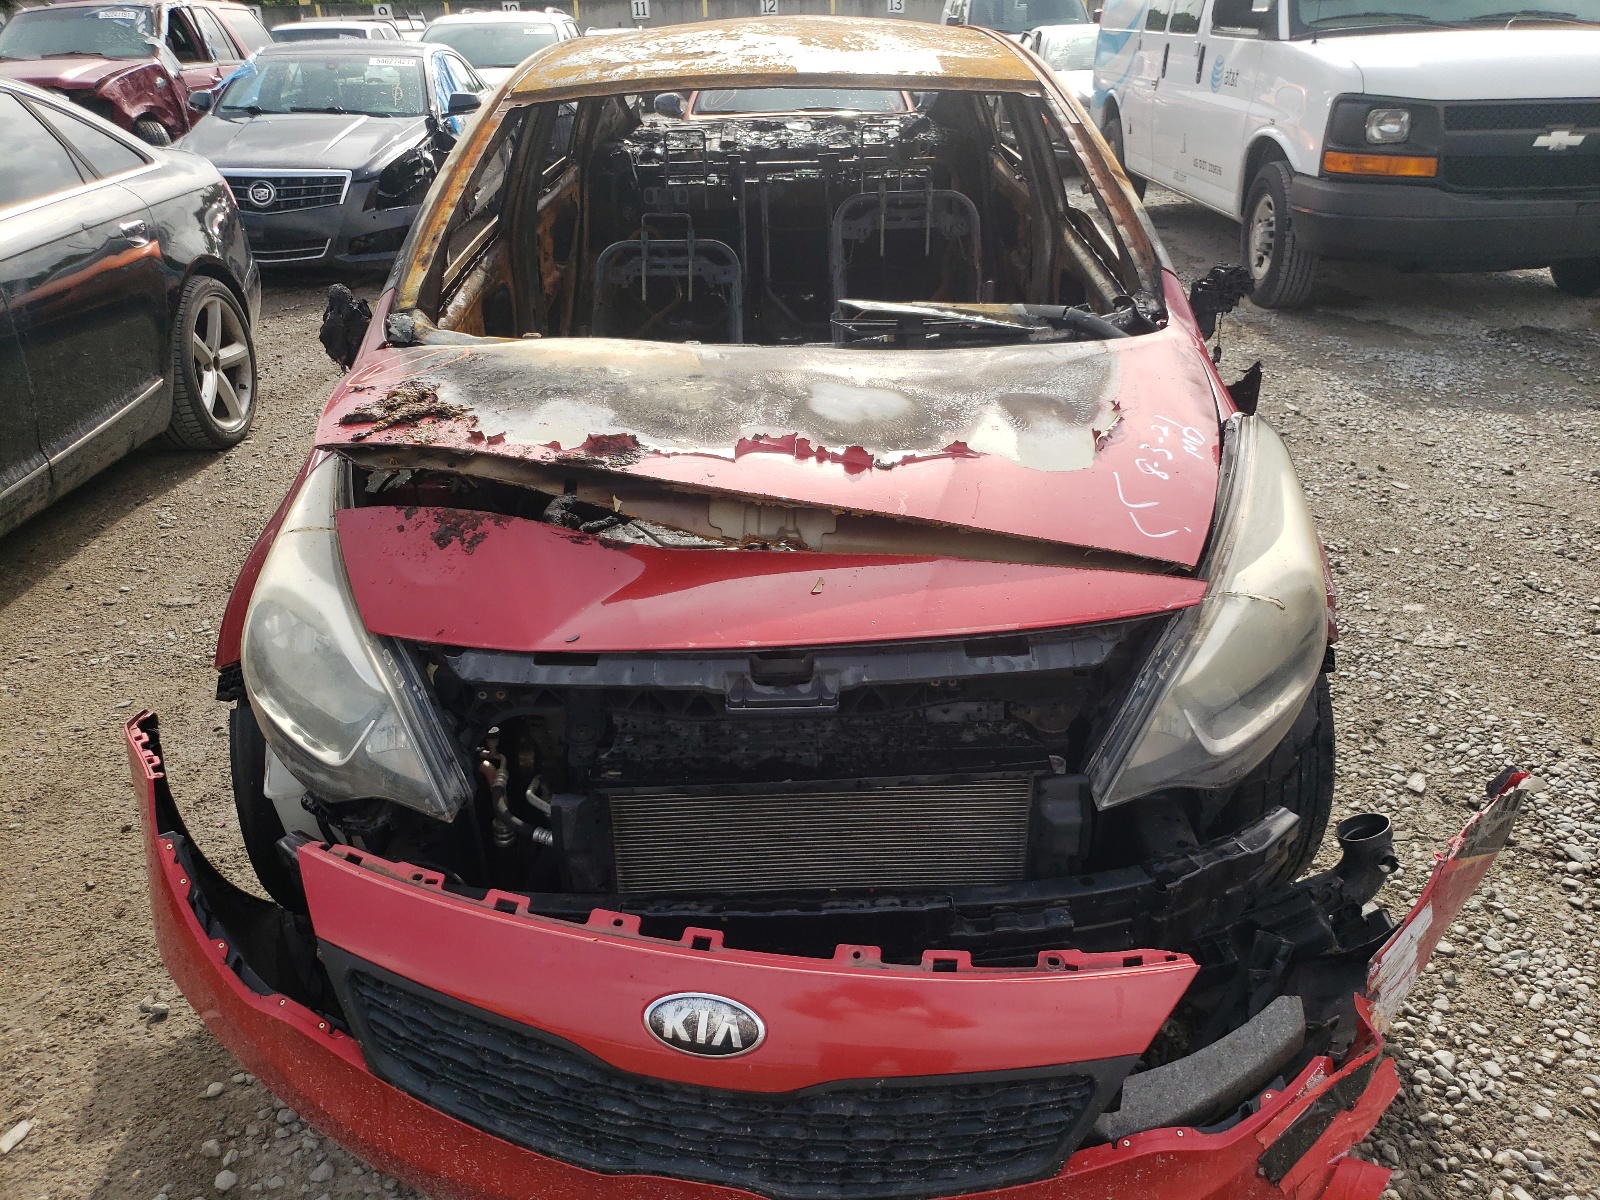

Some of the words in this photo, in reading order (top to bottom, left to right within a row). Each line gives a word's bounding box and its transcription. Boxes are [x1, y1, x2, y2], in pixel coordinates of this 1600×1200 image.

[634, 1, 646, 16] 11
[763, 0, 776, 13] 12
[889, 0, 903, 11] 13
[663, 1007, 743, 1049] KIA
